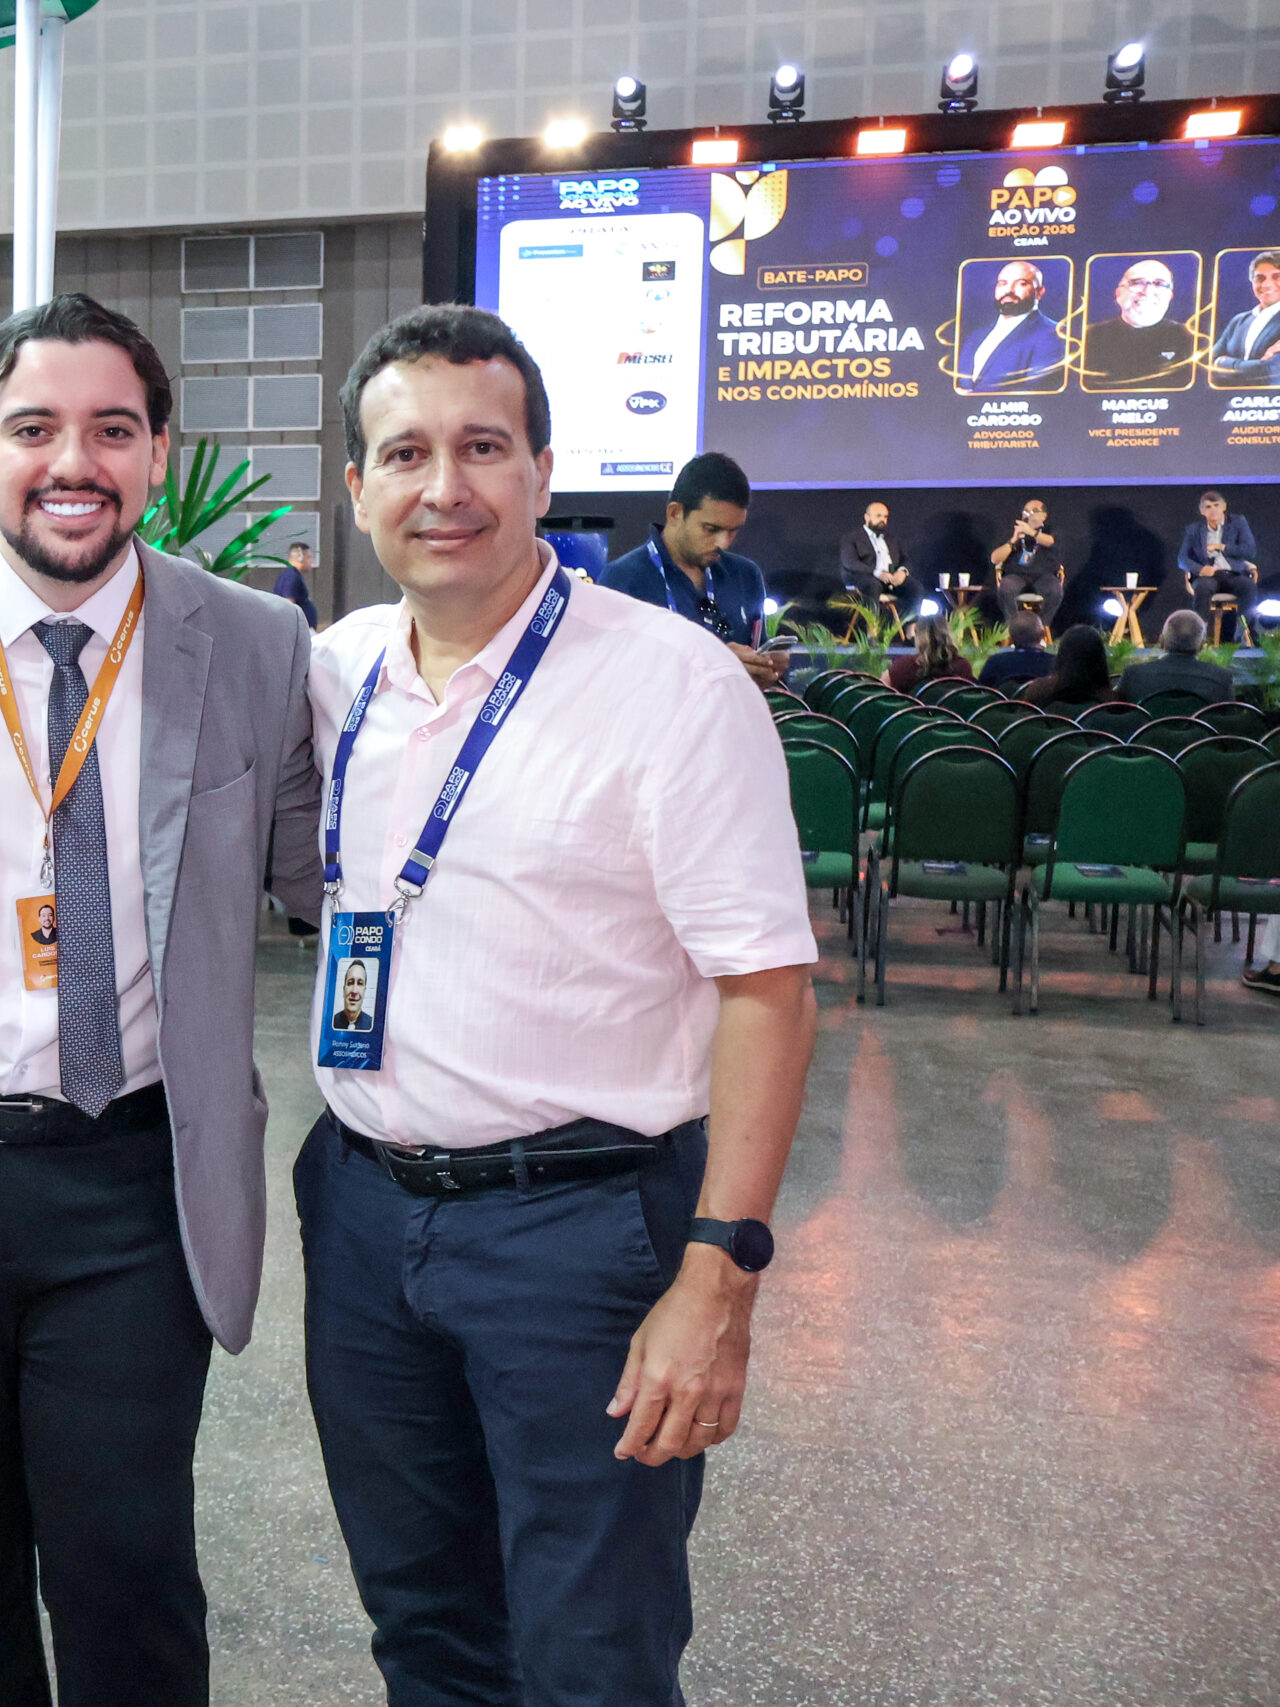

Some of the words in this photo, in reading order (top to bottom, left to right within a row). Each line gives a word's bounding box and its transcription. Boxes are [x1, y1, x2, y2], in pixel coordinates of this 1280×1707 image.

[560, 178, 640, 194] PAPO
[560, 198, 588, 209] AO
[591, 196, 640, 208] VIVO
[990, 186, 1077, 210] PAPO
[989, 209, 1022, 225] AO
[1023, 206, 1077, 223] VIVO
[988, 224, 1040, 237] EDIÇÃO
[1042, 224, 1076, 235] 2026
[763, 268, 864, 285] BATE-PAPO
[719, 298, 894, 328] REFORMA
[717, 322, 925, 356] TRIBUTÁRIA
[718, 366, 731, 382] E
[738, 357, 892, 381] IMPACTOS
[717, 386, 762, 401] NOS
[767, 379, 919, 401] CONDOMÍNIOS
[981, 401, 1029, 414] ALMIR
[1102, 398, 1169, 411] MARCUS
[966, 414, 1042, 427] CARDOSO
[1112, 411, 1157, 424] MELO
[1223, 409, 1280, 421] AUGUS
[973, 430, 1034, 439] ADVOGADO
[1088, 428, 1112, 437] VICE
[1114, 427, 1180, 437] PRESIDENTE
[967, 440, 1039, 449] TRIBUTARISTA
[1106, 438, 1160, 447] ADCONCE
[538, 588, 556, 616] PAPO
[116, 610, 134, 649] cerus
[489, 672, 512, 704] PAPO
[495, 675, 516, 707] CONDO
[81, 697, 101, 737] cerus
[441, 766, 460, 799] PAPO
[446, 768, 464, 801] CONDO
[355, 926, 383, 936] PAPO
[354, 935, 383, 944] CONDO
